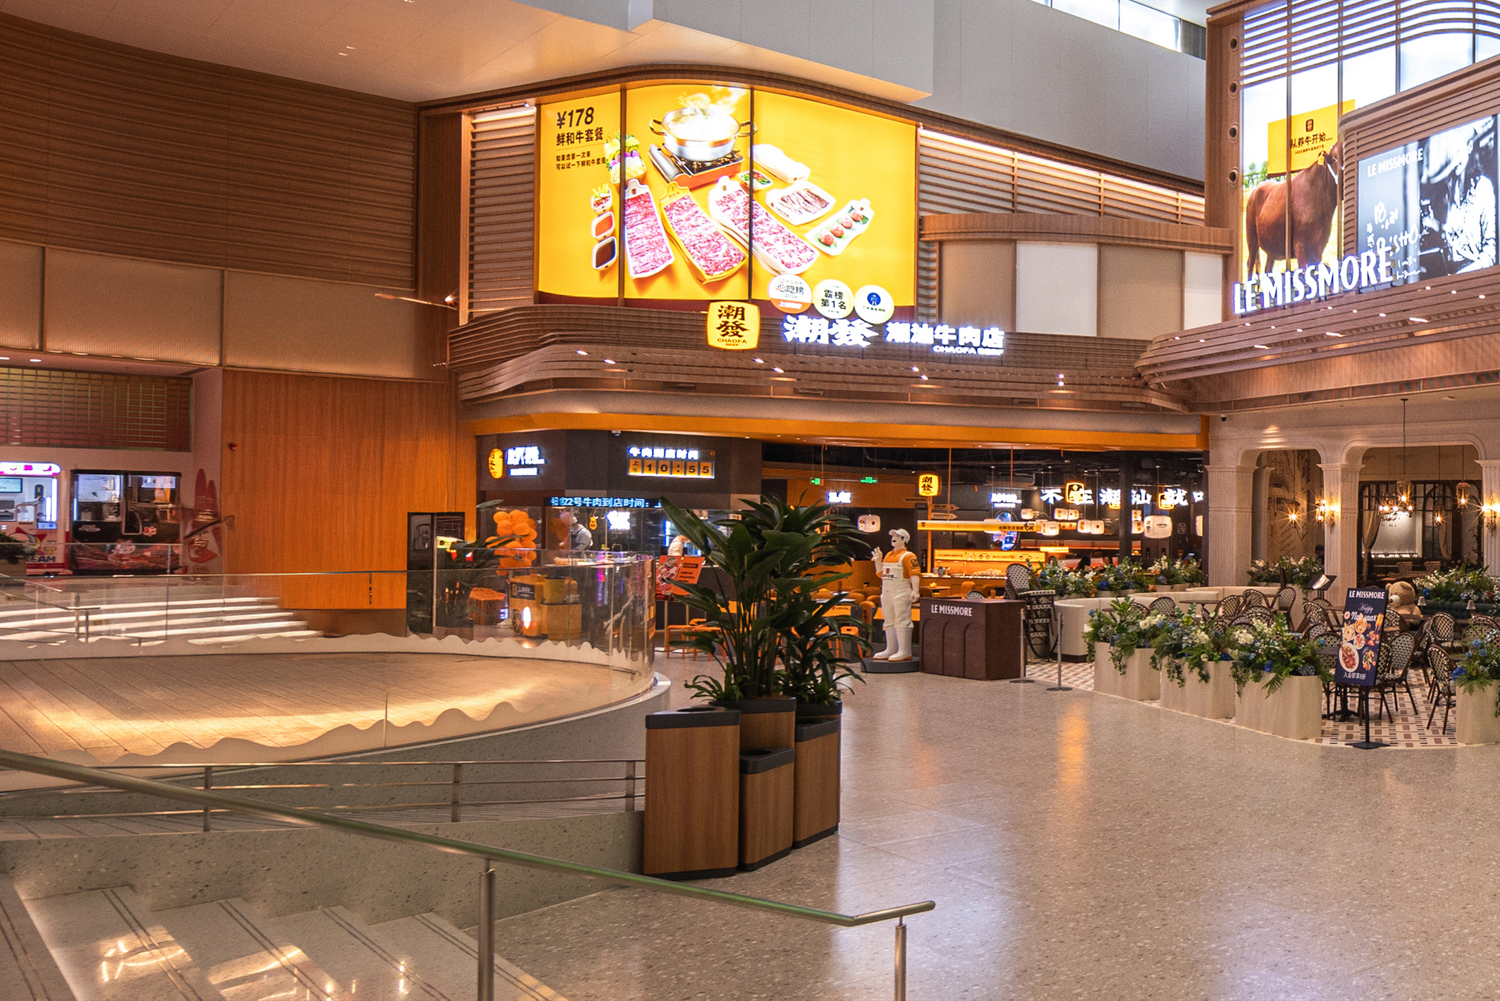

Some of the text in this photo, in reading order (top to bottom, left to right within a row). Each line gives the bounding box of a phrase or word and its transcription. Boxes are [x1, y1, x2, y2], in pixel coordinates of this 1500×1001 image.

[556, 107, 594, 129] ¥178
[556, 127, 603, 146] 鲜和牛套餐
[1367, 148, 1423, 177] LE MISSMORE
[1233, 279, 1258, 314] LE
[1259, 246, 1394, 309] MISSMORE
[823, 289, 843, 300] 霸榜
[821, 298, 847, 310] 第1名
[716, 305, 749, 339] 潮發
[646, 463, 710, 474] 10:55
[1349, 590, 1385, 600] LE MISSMORE
[931, 604, 972, 617] LE MISSMORE
